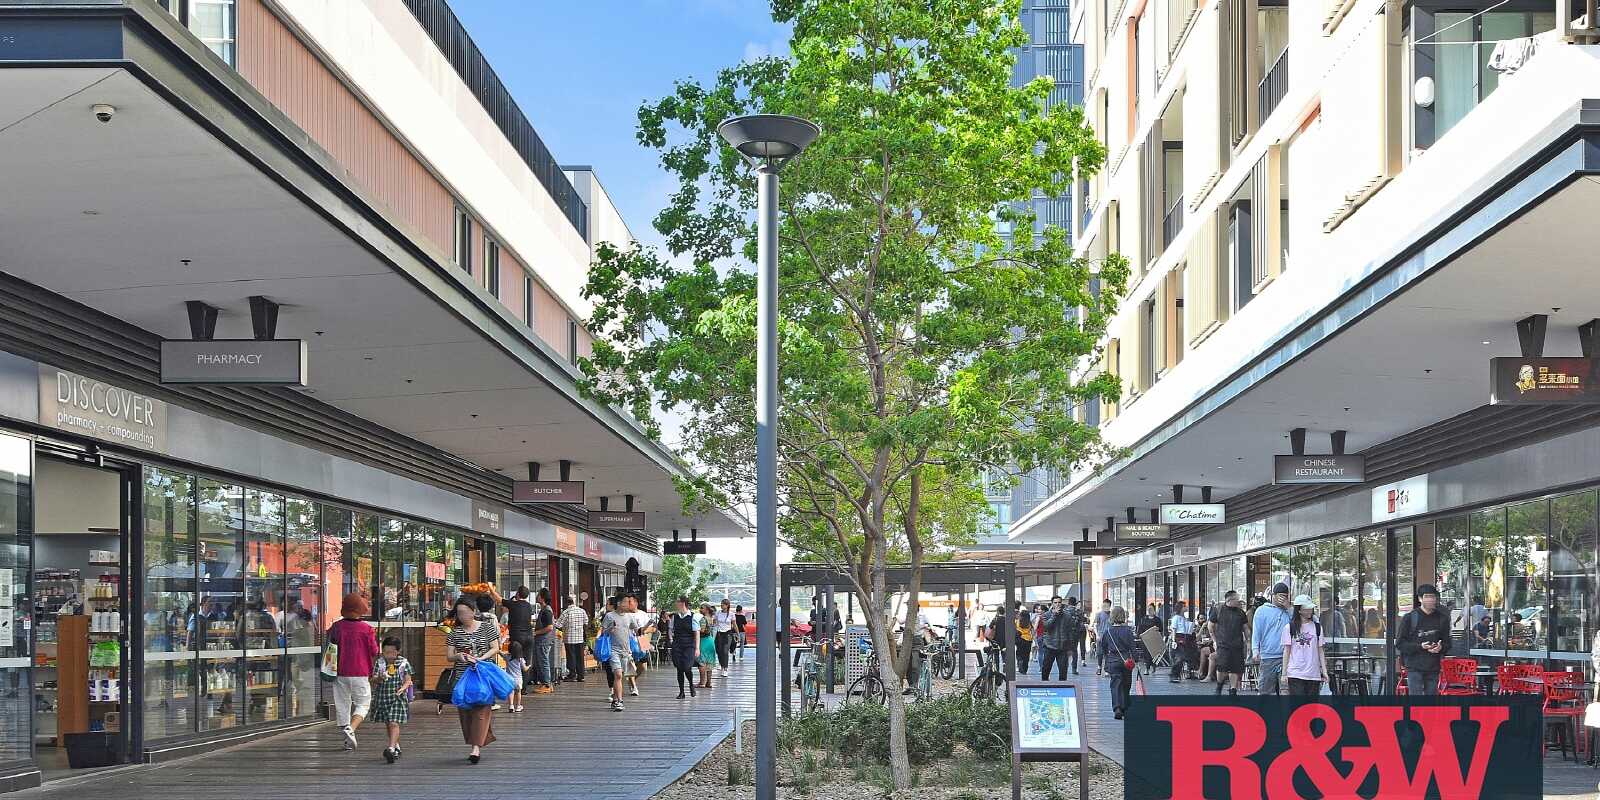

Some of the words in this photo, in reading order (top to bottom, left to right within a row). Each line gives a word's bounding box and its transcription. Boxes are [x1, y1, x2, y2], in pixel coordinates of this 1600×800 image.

[197, 353, 262, 366] PHARMACY
[56, 371, 155, 427] DISCOVER
[57, 411, 97, 431] pharmacy
[107, 424, 155, 449] compounding
[1304, 459, 1336, 467] CHINESE
[1295, 468, 1344, 476] RESTAURANT
[1178, 509, 1217, 519] Chatime
